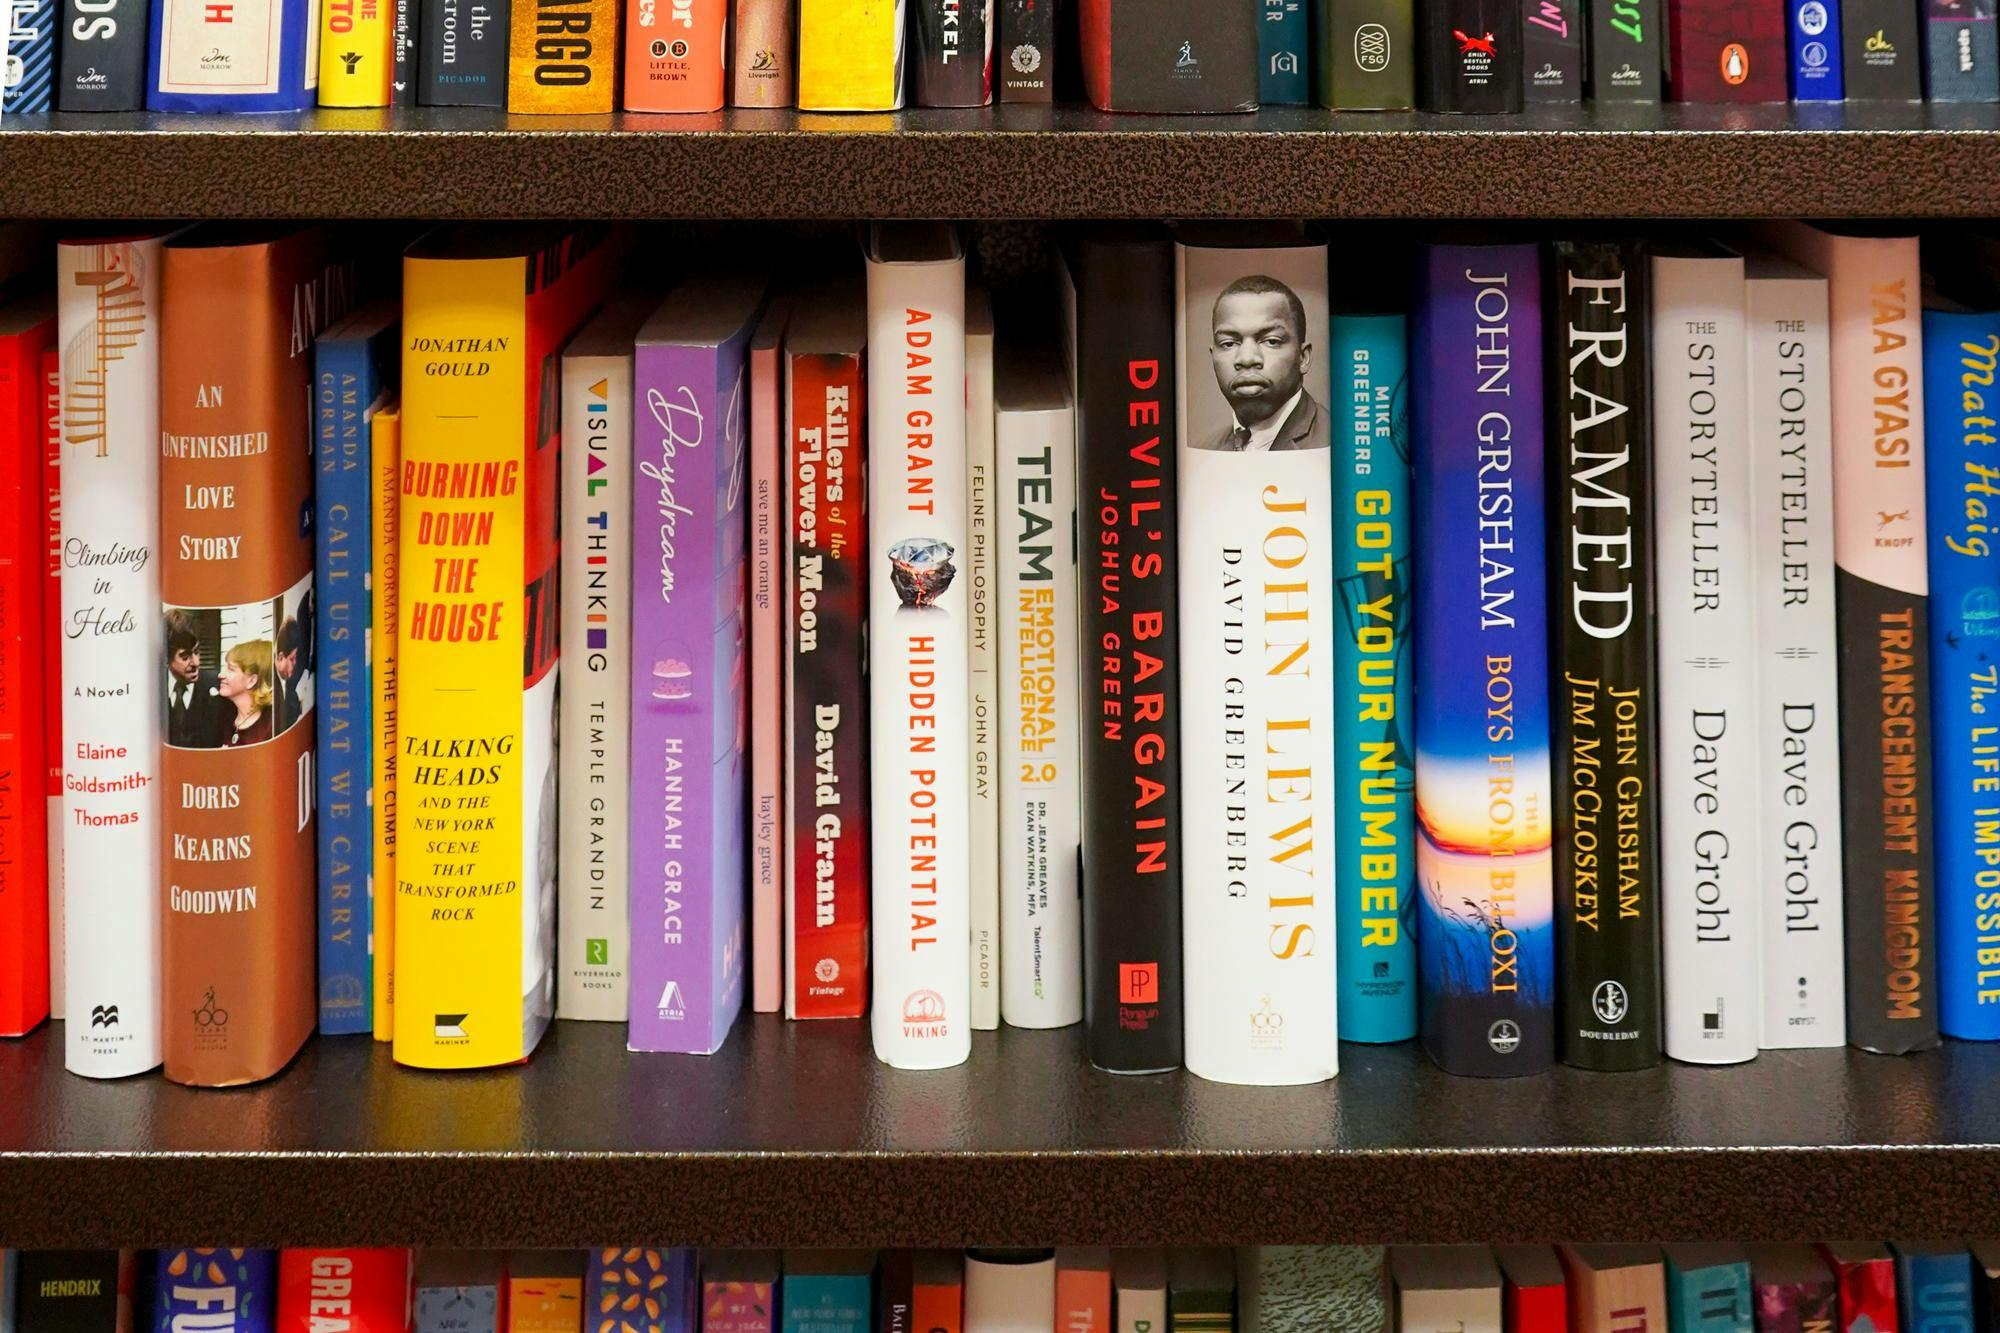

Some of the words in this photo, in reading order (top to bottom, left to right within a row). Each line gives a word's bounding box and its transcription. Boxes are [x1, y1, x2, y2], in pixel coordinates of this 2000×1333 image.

[396, 14, 408, 31] HEN
[470, 5, 491, 41] the
[395, 33, 406, 63] PRESS
[650, 62, 691, 70] LITTLE,
[1361, 55, 1385, 64] FSG
[1958, 28, 1973, 72] speak
[439, 75, 487, 83] PICADOR
[650, 73, 688, 81] BROWN
[1007, 80, 1044, 88] VINTAGE
[1465, 268, 1511, 396] JOHN
[1686, 321, 1717, 335] THE
[1776, 320, 1806, 333] THE
[1871, 278, 1908, 354] YAA
[410, 337, 510, 352] JONATHAN
[425, 362, 490, 377] GOULD
[906, 308, 932, 395] ADAM
[195, 384, 223, 408] AN
[1353, 349, 1371, 475] GREENBERG
[1375, 386, 1391, 438] MIKE
[1961, 334, 2000, 446] Matt
[322, 373, 336, 472] GORMAN
[342, 374, 357, 470] AMANDA
[1873, 366, 1911, 469] GYASI
[162, 432, 268, 458] UNFINISHED
[825, 385, 849, 503] Killers
[907, 410, 933, 515] GRANT
[1129, 359, 1162, 579] DEVIL'S
[1568, 269, 1633, 640] FRAMED
[185, 485, 235, 510] LOVE
[403, 460, 519, 499] BURNING
[640, 385, 704, 604] Daydream
[758, 479, 769, 512] save
[799, 427, 822, 548] Flower
[973, 465, 985, 527] FELINE
[1688, 343, 1720, 614] STORYTELLER
[1779, 341, 1809, 609] STORYTELLER
[384, 466, 397, 546] AMANDA
[418, 511, 494, 546] DOWN
[758, 516, 769, 534] me
[827, 507, 847, 526] of
[1018, 446, 1053, 581] TEAM
[1477, 411, 1515, 631] GRISHAM
[1945, 462, 2000, 557] Haig
[64, 537, 151, 574] Climbing
[180, 535, 241, 560] STORY
[329, 504, 349, 585] CALL
[758, 538, 769, 555] an
[830, 531, 847, 560] the
[1101, 487, 1120, 614] JOSHUA
[1356, 490, 1393, 580] GOT
[1875, 538, 1914, 548] KNOPF
[93, 578, 112, 595] in
[383, 553, 397, 635] GORMAN
[433, 558, 479, 594] THE
[755, 559, 769, 609] orange
[974, 534, 987, 652] PHILOSOPHY
[1222, 547, 1244, 655] DAVID
[1261, 485, 1310, 680] JOHN
[65, 605, 137, 639] Heels
[329, 603, 349, 641] US
[410, 602, 504, 642] HOUSE
[799, 555, 823, 653] Moon
[1019, 588, 1036, 752] INTELLIGENCE
[1036, 588, 1057, 753] EMOTIONAL
[1357, 594, 1395, 722] YOUR
[74, 688, 81, 697] A
[87, 684, 130, 698] Novel
[329, 659, 350, 752] WHAT
[384, 664, 397, 703] THE
[909, 636, 935, 753] HIDDEN
[1103, 633, 1123, 741] GREEN
[1486, 655, 1514, 743] BOYS
[1566, 672, 1600, 728] JIM
[1968, 665, 1998, 714] The
[383, 710, 397, 750] HILL
[590, 701, 605, 784] TEMPLE
[975, 694, 988, 744] JOHN
[1132, 611, 1167, 874] BARGAIN
[1609, 687, 1641, 766] JOHN
[1880, 607, 1919, 855] TRANSCENDENT
[77, 743, 127, 760] Elaine
[384, 755, 397, 782] WE
[405, 735, 514, 758] TALKING
[815, 704, 840, 807] David
[1693, 709, 1726, 814] Dave
[1782, 703, 1815, 806] Dave
[1971, 727, 2000, 793] LIFE
[66, 775, 153, 793] Goldsmith-
[182, 783, 240, 809] DORIS
[330, 770, 350, 818] WE
[414, 765, 502, 786] HEADS
[664, 738, 683, 850] HANNAH
[976, 750, 989, 800] GRAY
[1021, 763, 1057, 783] 2.0
[1224, 677, 1248, 898] GREENBERG
[74, 809, 139, 827] Thomas
[384, 791, 397, 850] CLIMB
[413, 817, 449, 831] NEW
[454, 817, 496, 831] YORK
[418, 796, 452, 809] AND
[457, 796, 491, 808] THE
[758, 795, 775, 842] hayley
[1026, 802, 1035, 832] EVAN
[1038, 802, 1046, 821] DR.
[1487, 755, 1516, 859] FROM
[1523, 795, 1538, 833] THE
[174, 834, 251, 861] KEARNS
[426, 841, 480, 853] SCENE
[590, 798, 605, 910] GRANDIN
[910, 769, 937, 952] POTENTIAL
[1027, 835, 1036, 889] WATKINS,
[1038, 824, 1047, 853] JEAN
[1265, 716, 1316, 960] LEWIS
[1359, 742, 1398, 948] NUMBER
[1616, 776, 1642, 920] GRISHAM
[398, 880, 516, 898] TRANSFORMED
[433, 863, 475, 876] THAT
[757, 846, 771, 885] grace
[815, 813, 841, 928] Grann
[1039, 857, 1048, 909] GREAVES
[1694, 830, 1731, 943] Grohl
[1784, 821, 1819, 934] Grohl
[171, 886, 257, 914] GOODWIN
[331, 836, 352, 946] CARRY
[431, 908, 475, 920] ROCK
[664, 860, 682, 945] GRACE
[1028, 893, 1036, 917] MFA
[1974, 808, 2000, 1006] IMPOSSIBLE
[980, 930, 989, 989] PICADOR
[1883, 869, 1922, 1019] KINGDOM
[658, 1009, 685, 1017] ATRIA
[809, 986, 845, 995] Vintage
[1119, 1007, 1160, 1019] Penguin
[903, 1026, 948, 1039] VIKING
[1119, 1018, 1149, 1030] Press
[1580, 1029, 1640, 1040] DOUBLEDAY
[40, 1280, 101, 1298] HENDRIX
